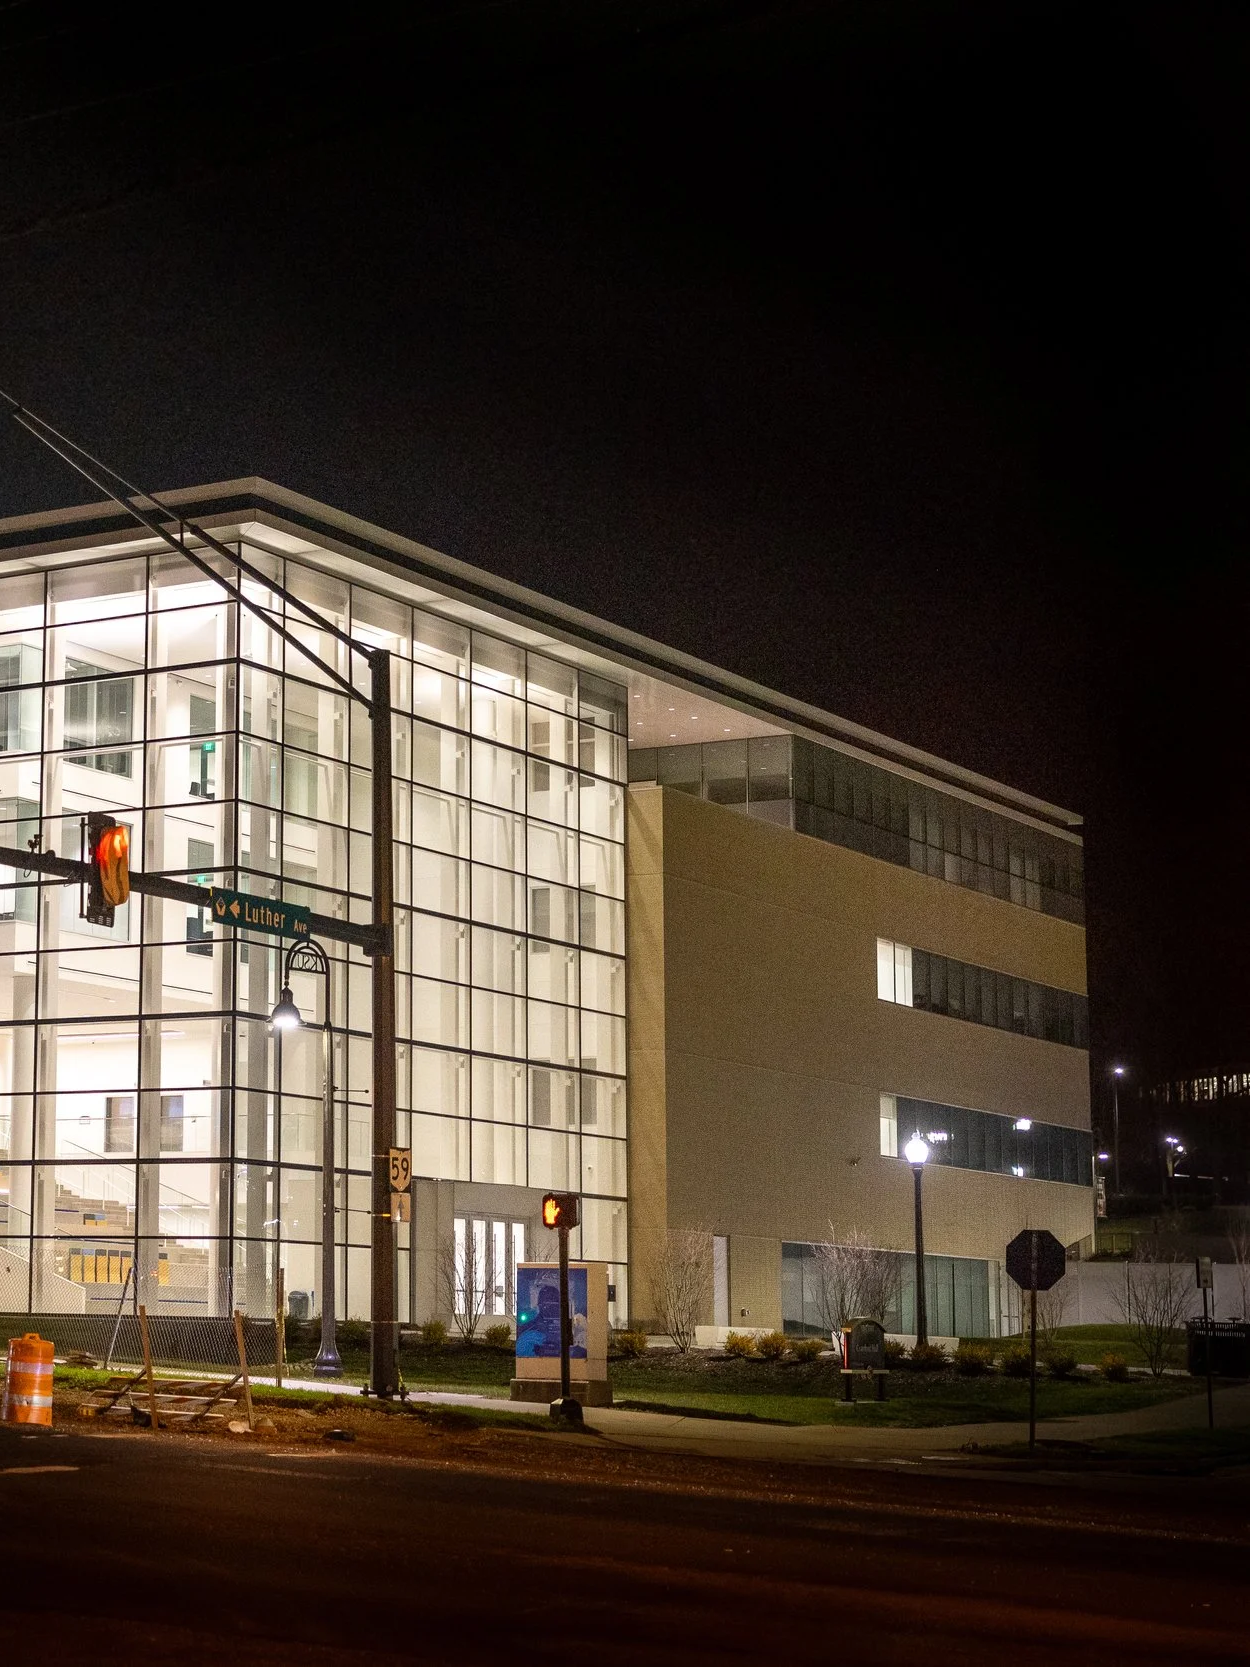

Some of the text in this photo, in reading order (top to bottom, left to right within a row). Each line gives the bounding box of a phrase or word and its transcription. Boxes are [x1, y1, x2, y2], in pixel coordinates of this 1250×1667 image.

[244, 902, 308, 934] Luther Ave
[391, 1156, 410, 1181] 59
